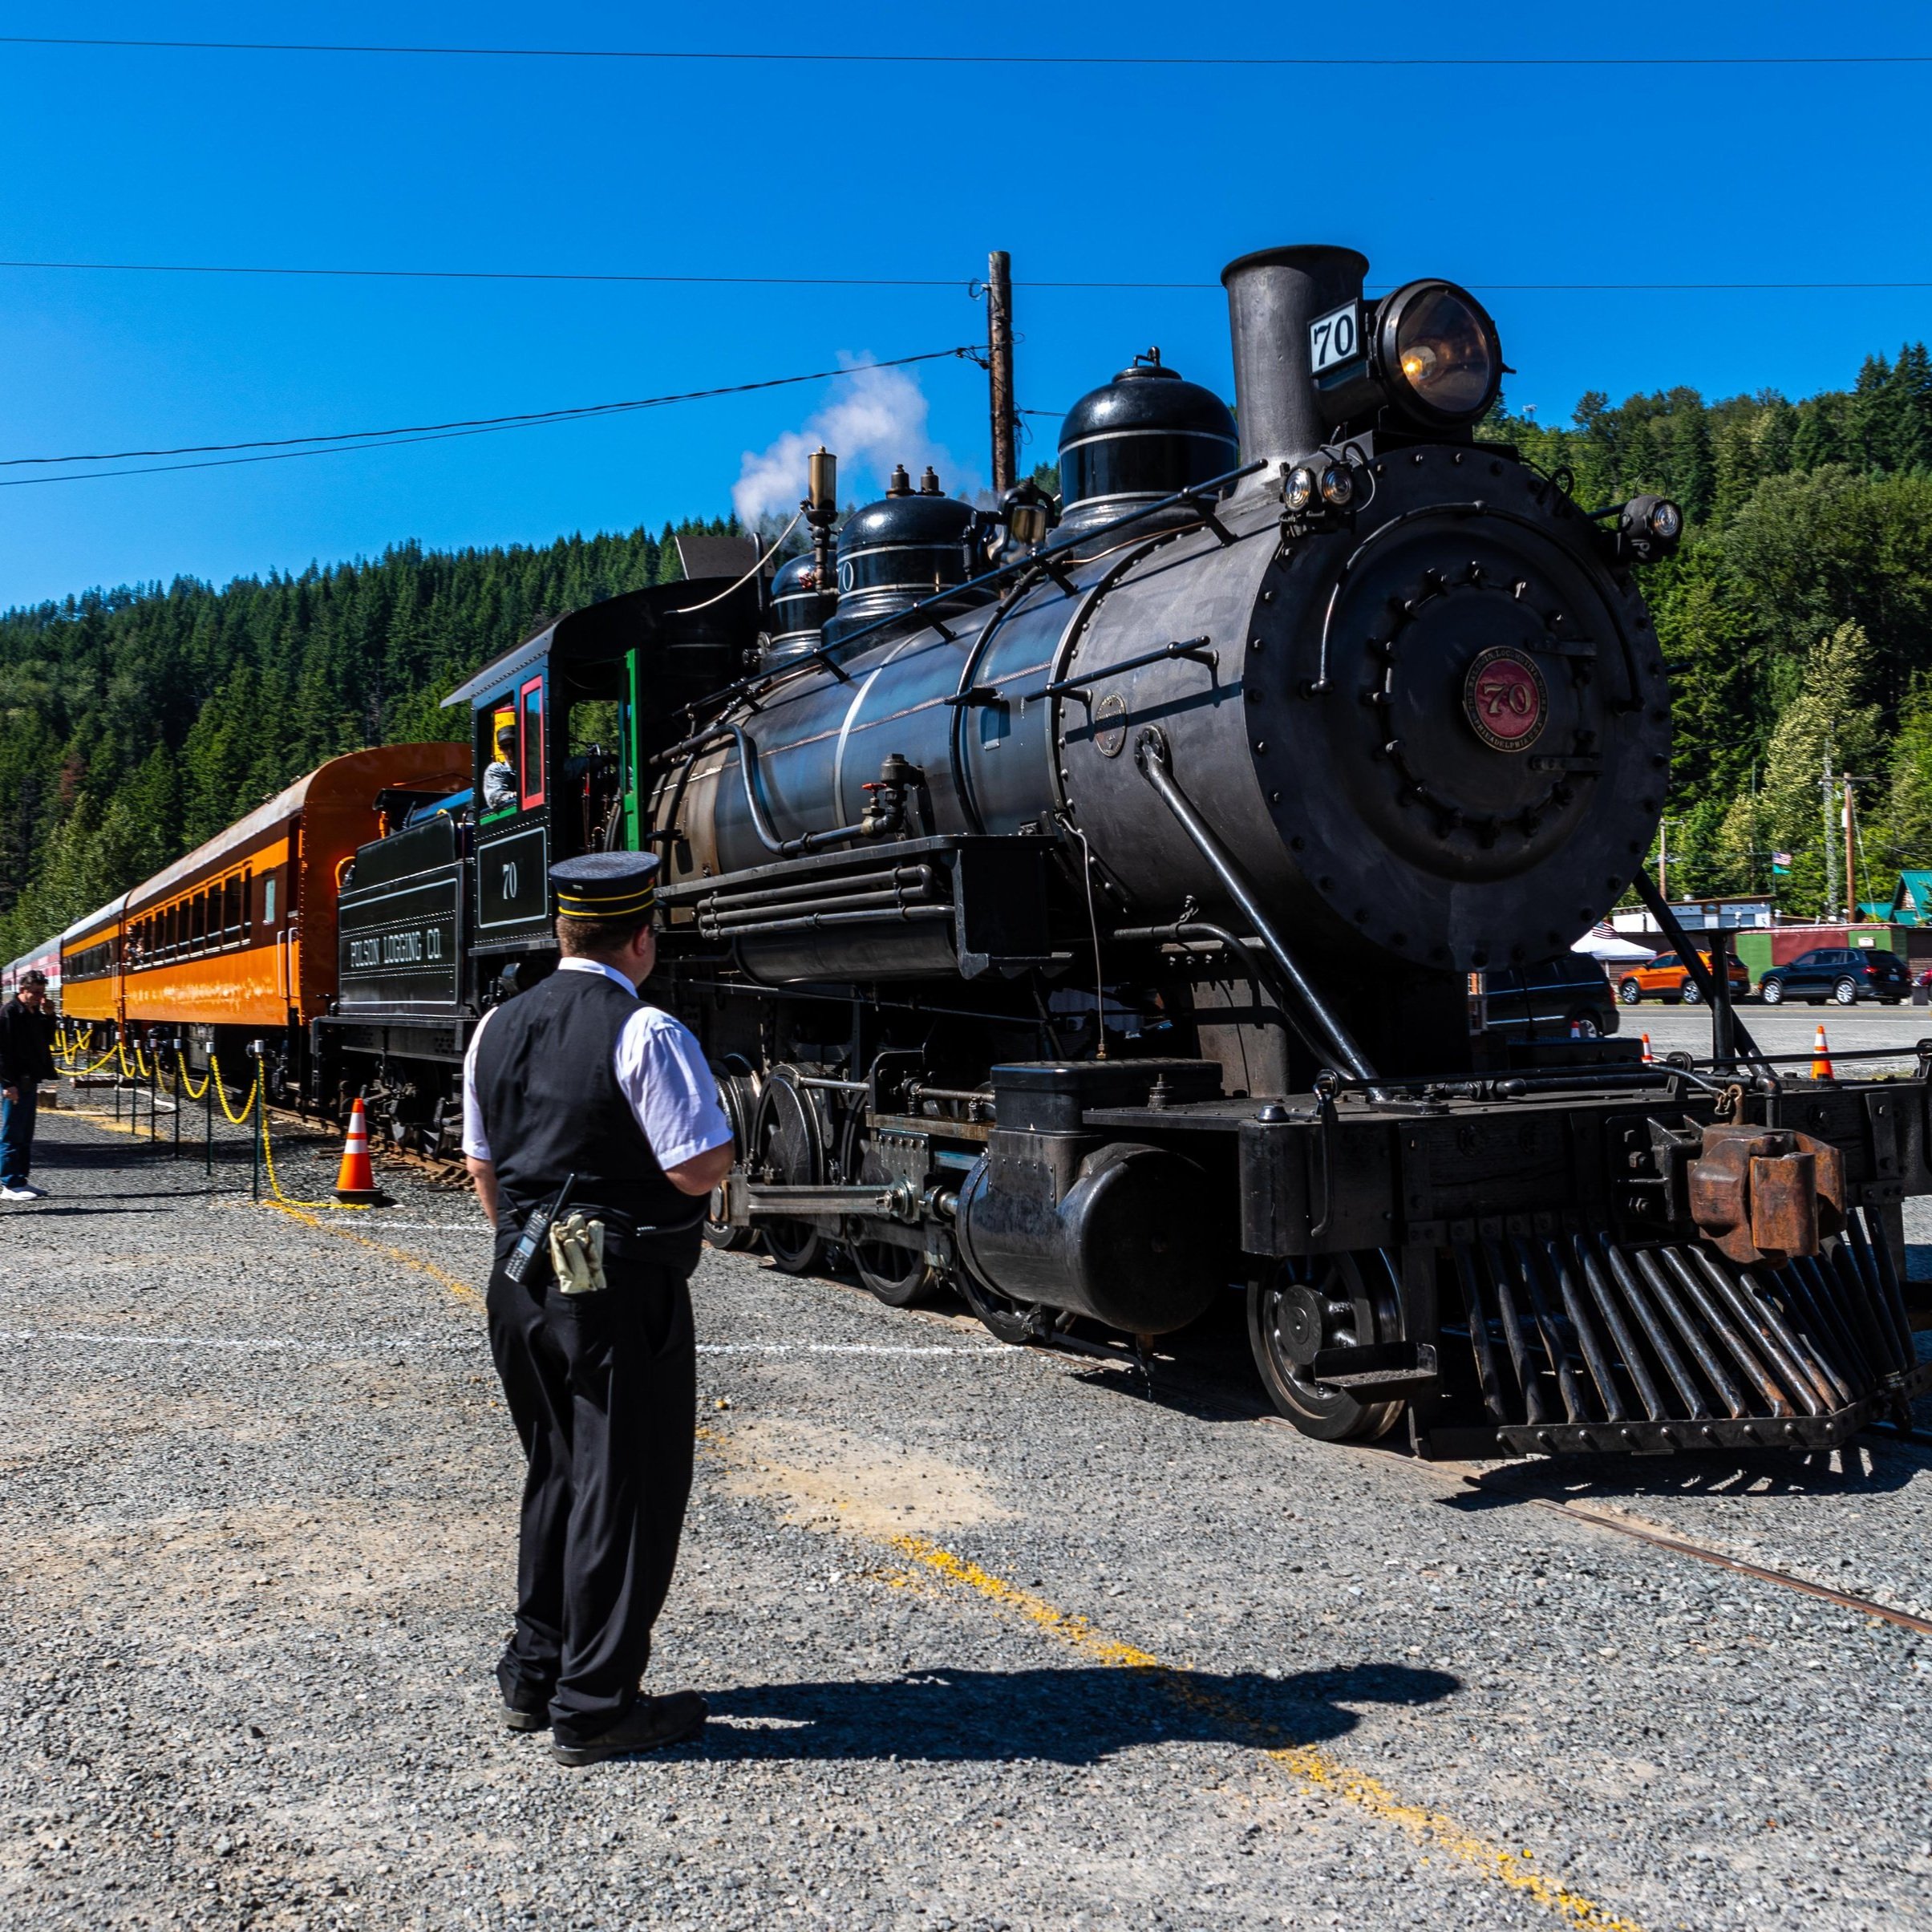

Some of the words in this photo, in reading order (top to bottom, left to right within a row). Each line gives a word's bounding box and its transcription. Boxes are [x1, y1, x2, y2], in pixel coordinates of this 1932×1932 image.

[1314, 314, 1354, 367] 70
[1484, 683, 1532, 715] 70
[502, 861, 517, 900] 70
[383, 930, 422, 964] LOGGING
